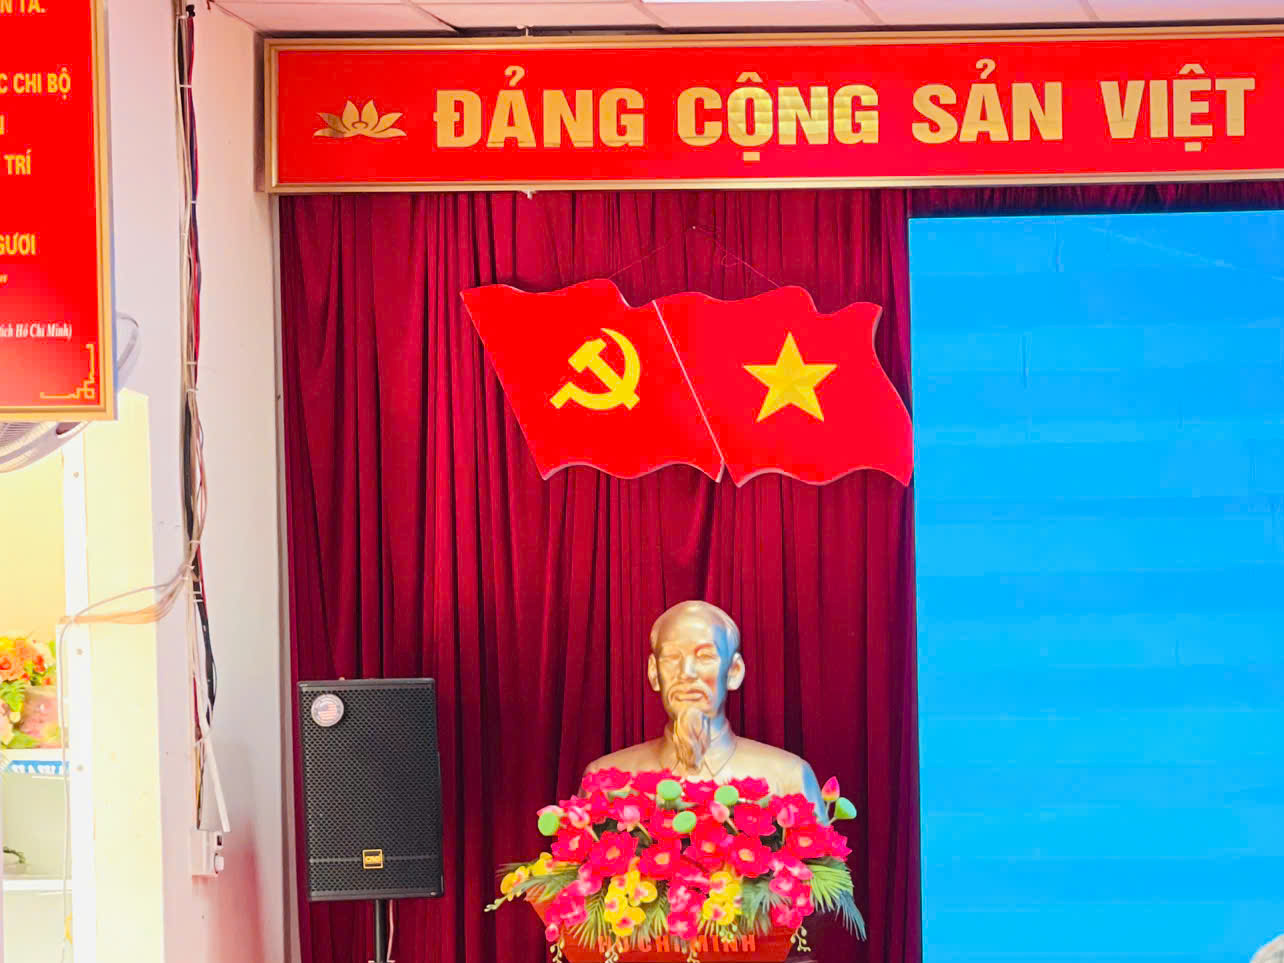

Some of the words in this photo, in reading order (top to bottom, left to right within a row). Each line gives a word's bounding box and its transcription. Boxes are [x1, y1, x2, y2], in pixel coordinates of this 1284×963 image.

[13, 74, 42, 94] CHI
[47, 67, 71, 100] BỘ
[434, 65, 645, 148] ĐẢNG
[677, 72, 879, 161] CỘNG
[911, 58, 1064, 144] SẢN
[1100, 63, 1256, 152] VIỆT
[4, 149, 31, 175] TRÍ
